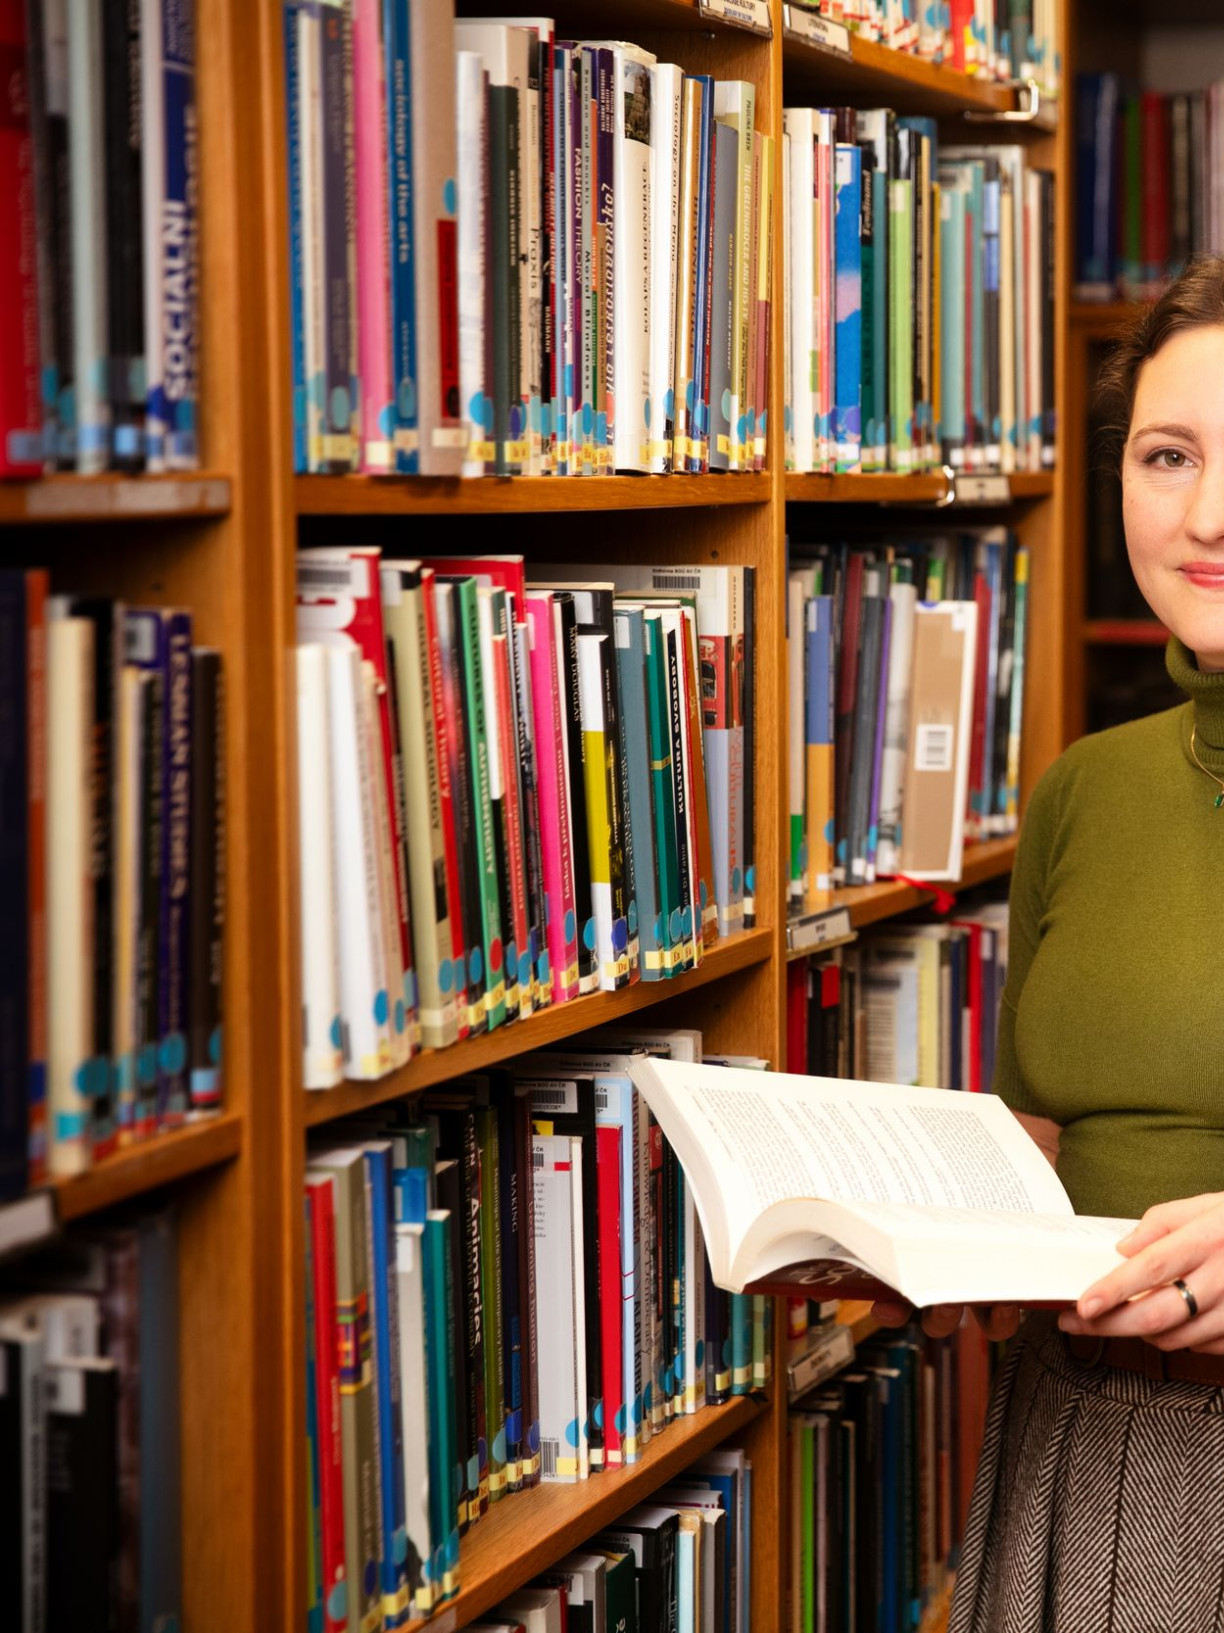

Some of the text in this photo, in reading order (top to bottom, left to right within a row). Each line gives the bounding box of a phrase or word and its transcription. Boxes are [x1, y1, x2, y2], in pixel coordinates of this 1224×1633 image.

[672, 94, 680, 164] Sociology
[743, 164, 752, 183] THE
[574, 148, 583, 285] FASHION THEORY
[672, 169, 678, 187] on
[743, 184, 752, 260] GREENGROCER
[742, 262, 750, 284] AND
[431, 636, 451, 798] Cultural Theory
[569, 625, 581, 722] MARY DOUGLAS
[417, 612, 440, 831] CULTURAL SOCIOLOGY
[469, 604, 495, 875] CULTURES OF AUTHENTICITY
[621, 777, 631, 857] PRACTICE
[675, 738, 685, 815] KULTURA
[510, 1172, 518, 1233] MAKING
[640, 1141, 650, 1236] Knowledge
[528, 1199, 537, 1295] becoming
[632, 1091, 642, 1394] DIGIMODERNISM ALAN KIRB
[641, 1260, 651, 1359] Democracy
